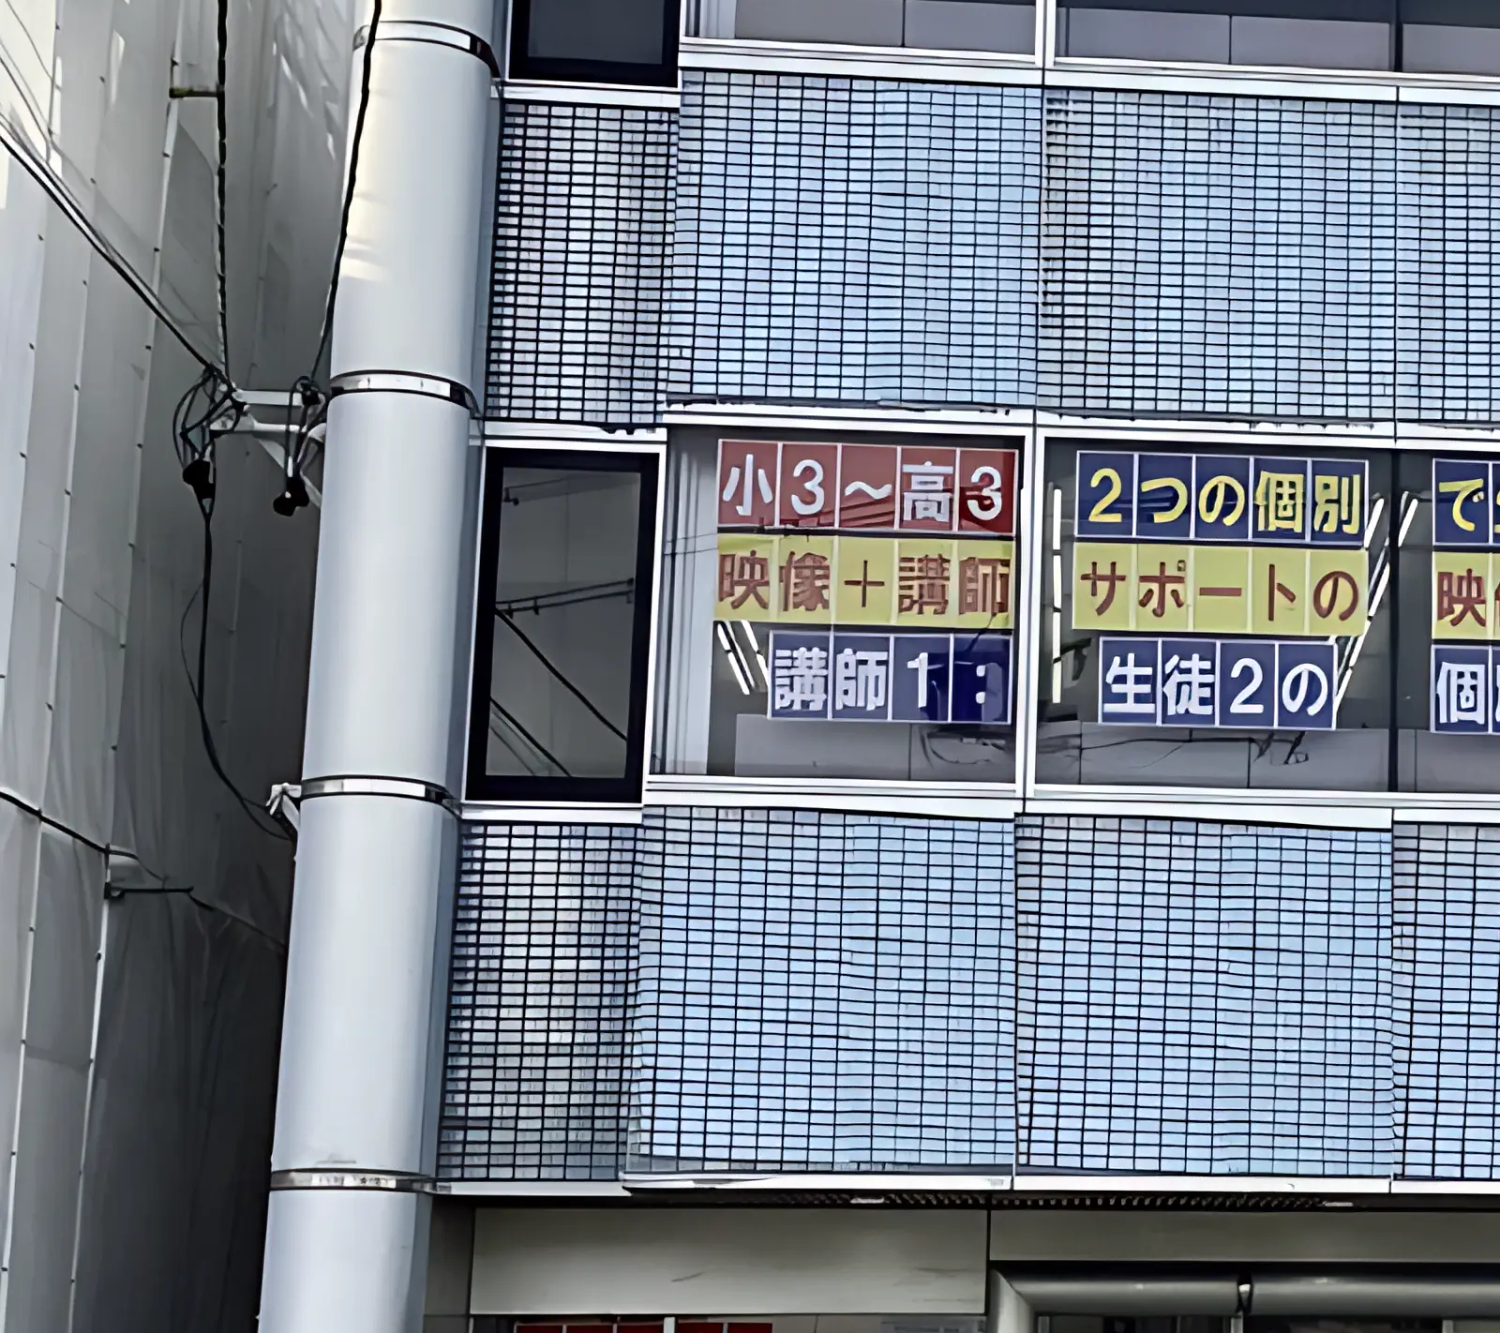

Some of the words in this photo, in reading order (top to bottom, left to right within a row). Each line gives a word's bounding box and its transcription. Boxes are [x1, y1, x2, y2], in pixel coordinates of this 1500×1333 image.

[1087, 467, 1361, 535] 2つの個別
[1080, 559, 1361, 622] サポートの
[1104, 654, 1330, 717] 生徒2の
